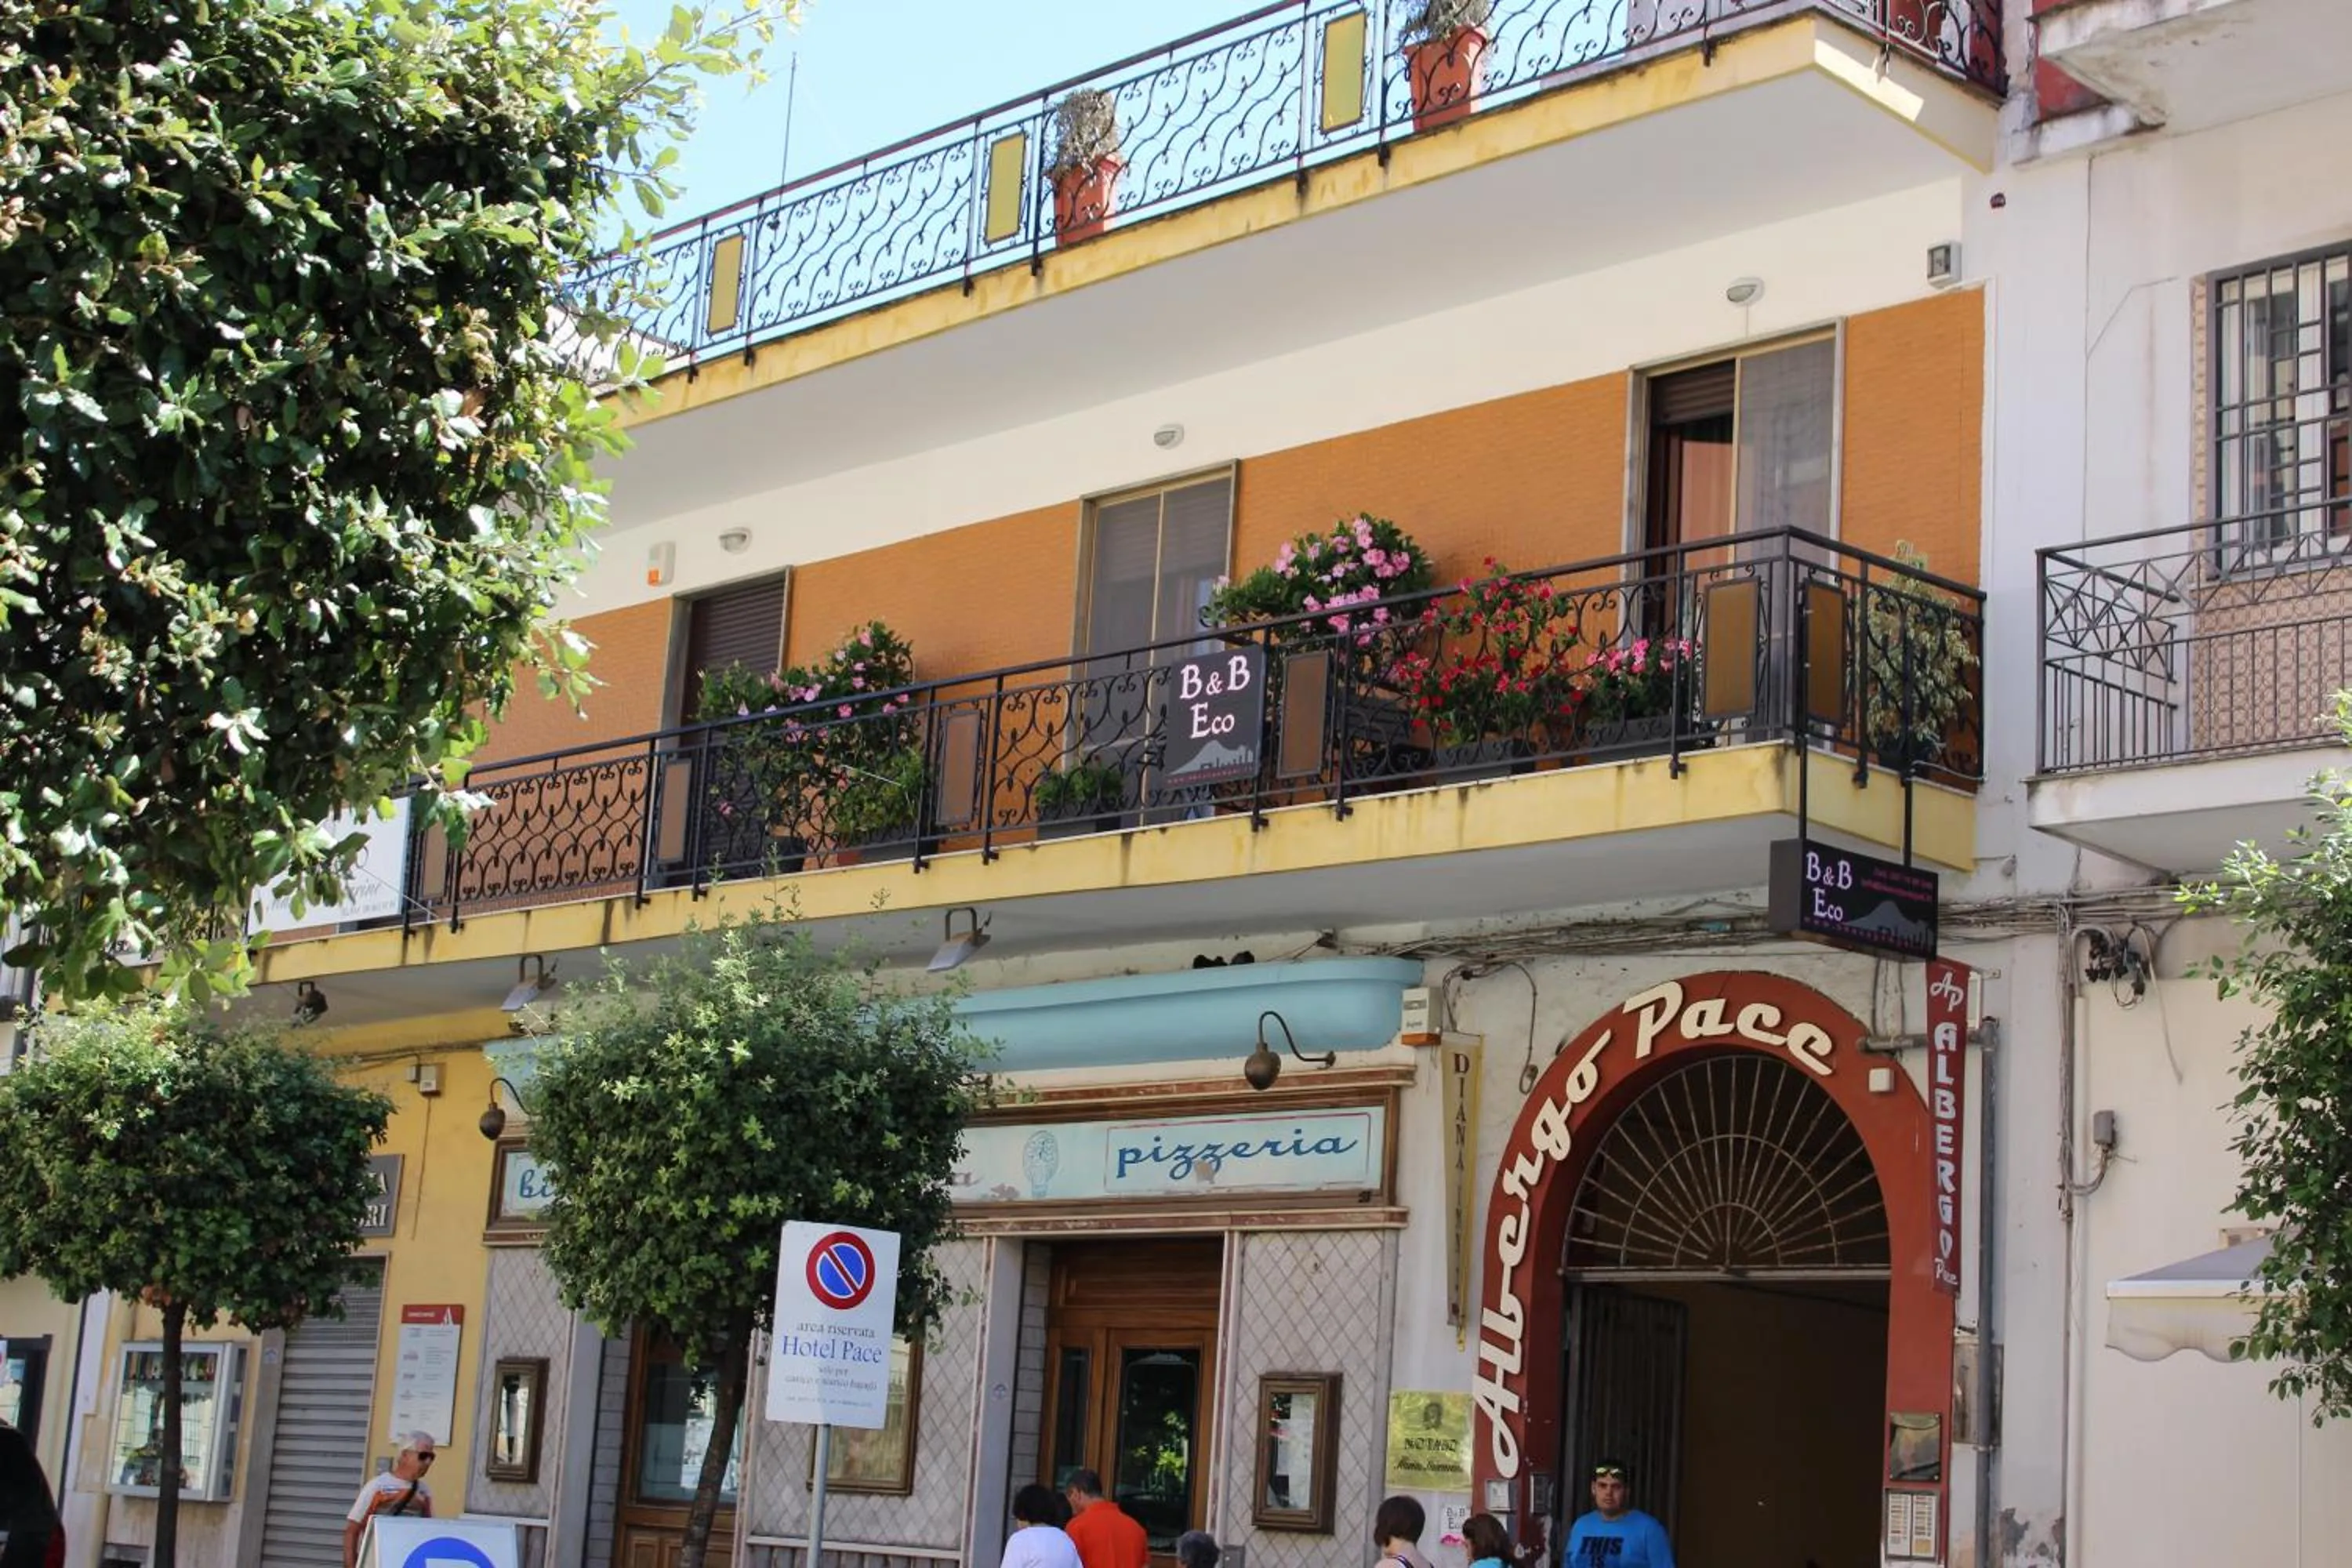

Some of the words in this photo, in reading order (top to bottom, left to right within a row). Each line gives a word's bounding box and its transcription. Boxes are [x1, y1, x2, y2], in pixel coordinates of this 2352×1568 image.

[1189, 702, 1235, 739] Eco
[1812, 887, 1843, 922] Eco
[1454, 1053, 1470, 1171] DIANA
[1116, 1128, 1359, 1181] pizzeria
[1933, 1022, 1958, 1259] ALBERGO
[1473, 1028, 1612, 1479] Albergo
[1622, 980, 1834, 1076] Pace
[782, 1335, 836, 1359] Hotel
[842, 1340, 882, 1363] Pace
[797, 1323, 825, 1333] area
[827, 1324, 876, 1338] riservata
[1580, 1536, 1624, 1556] THIS
